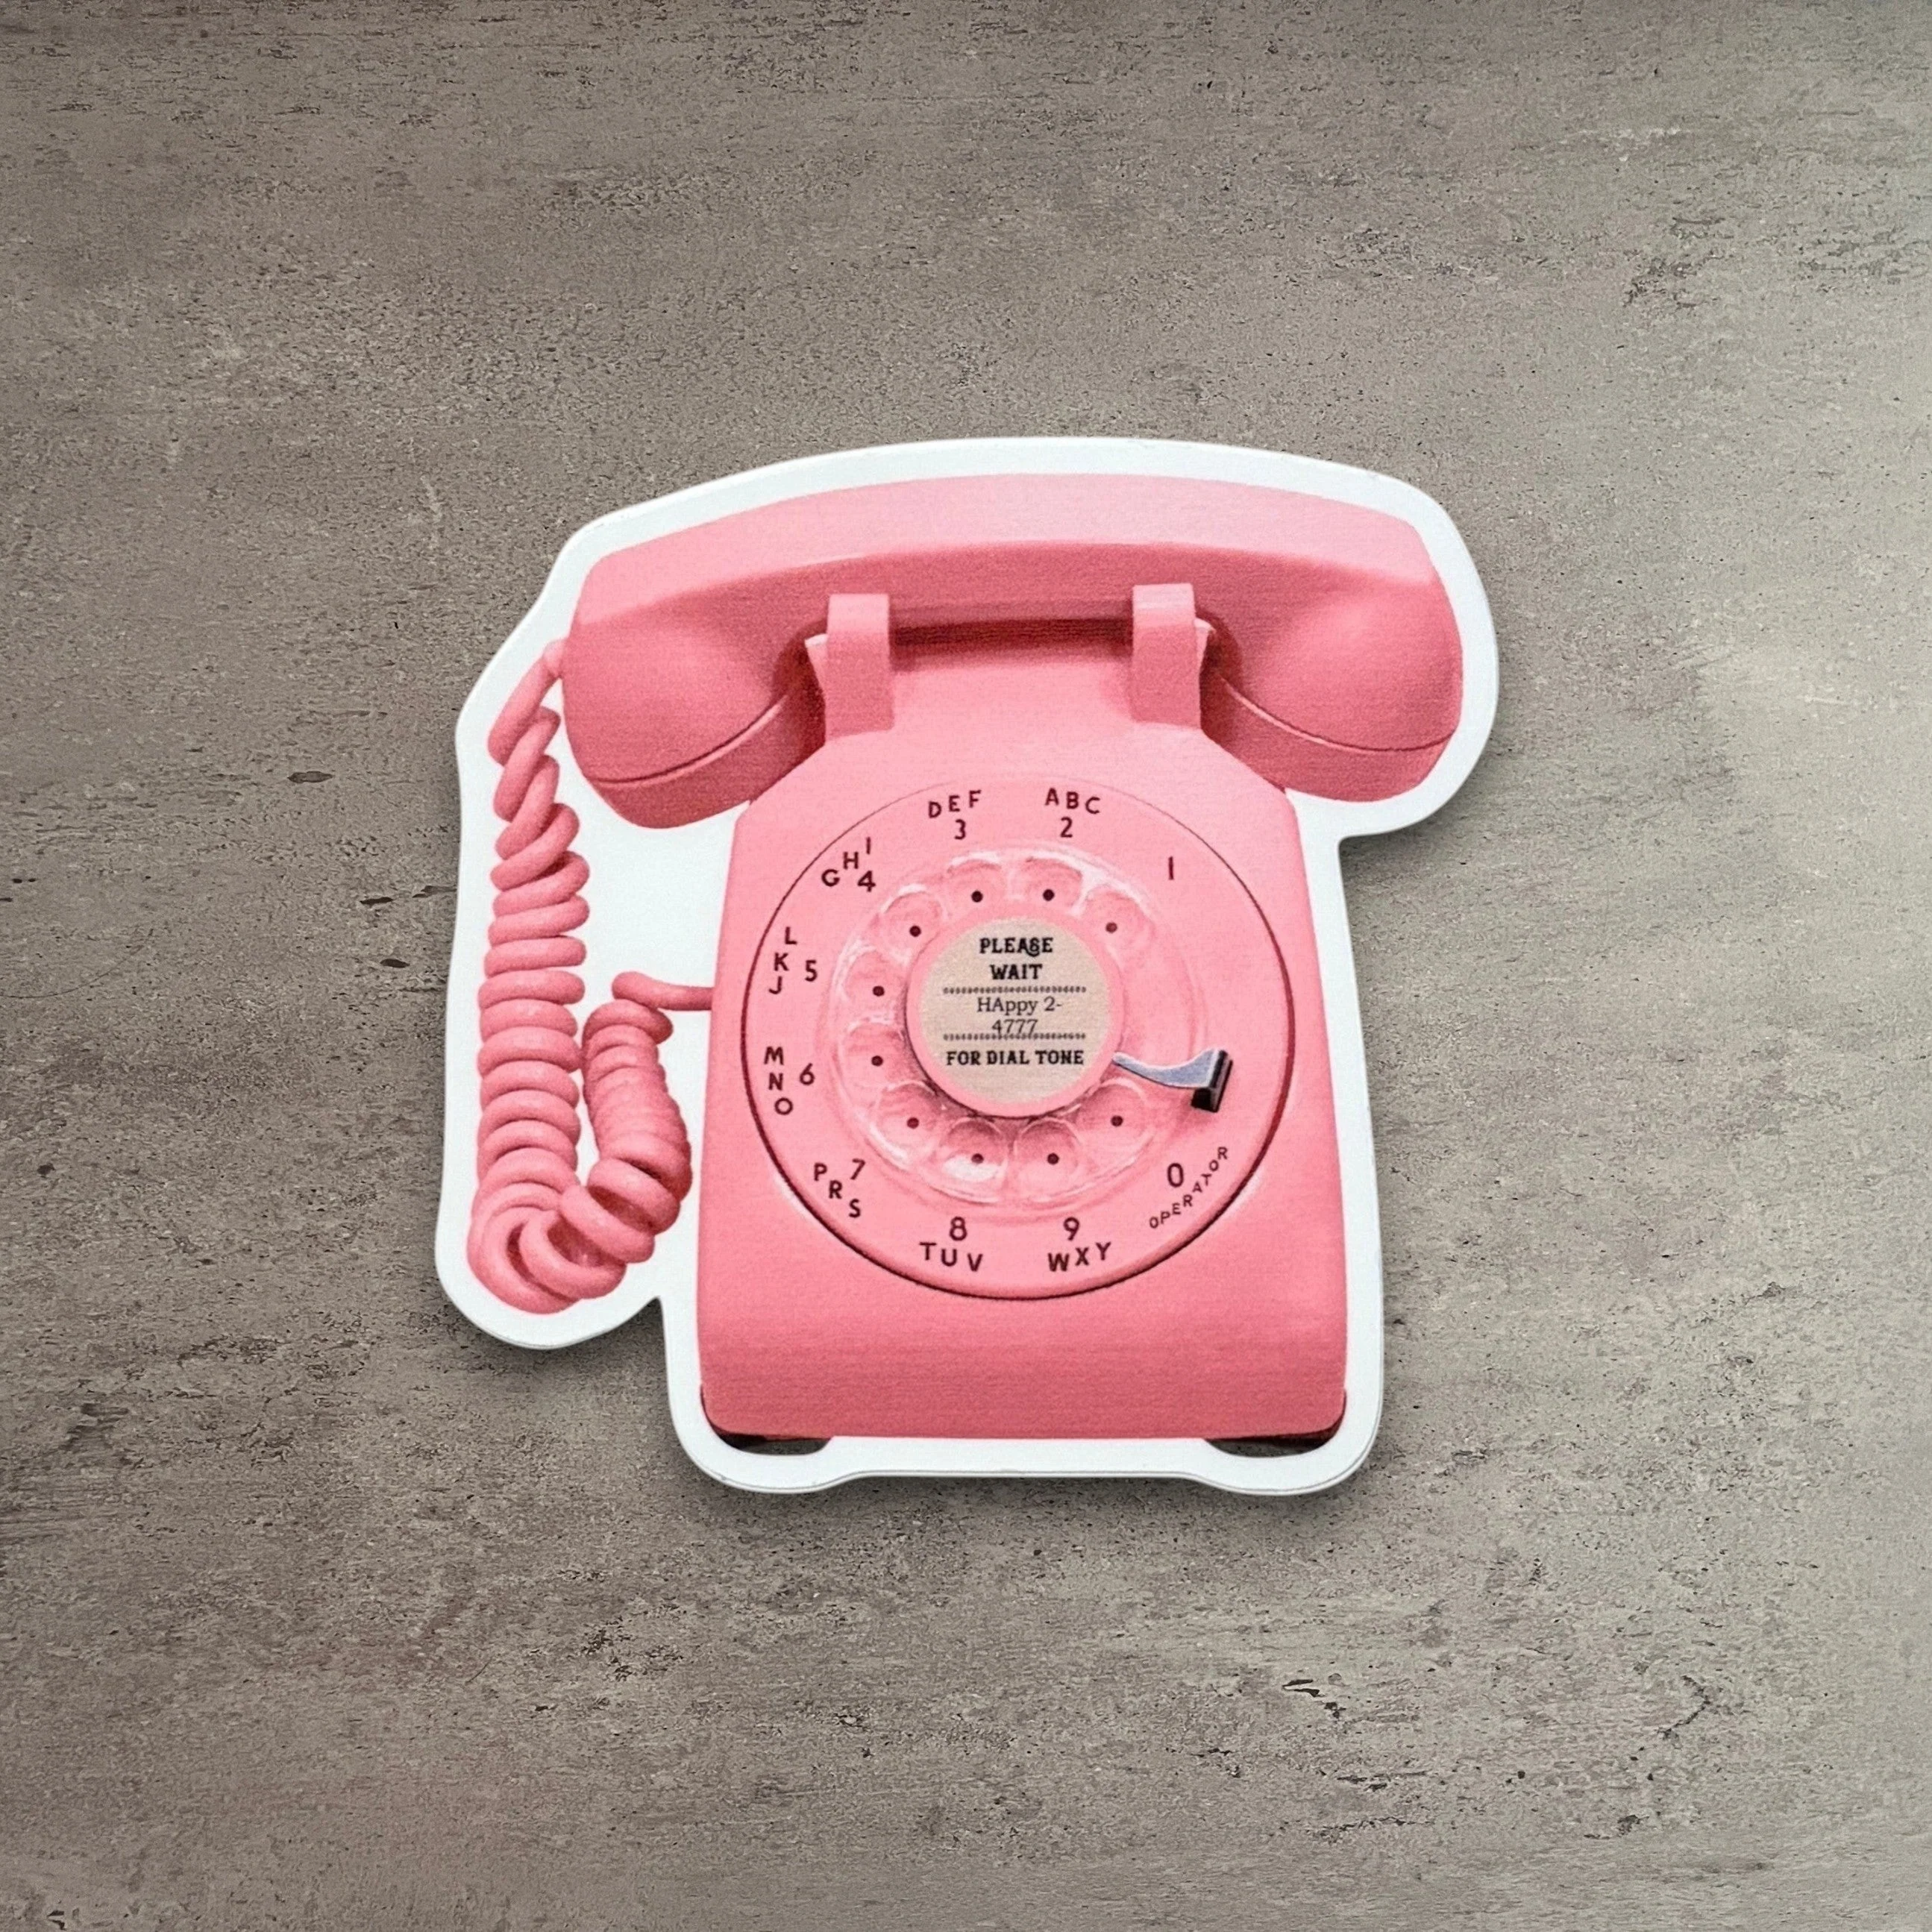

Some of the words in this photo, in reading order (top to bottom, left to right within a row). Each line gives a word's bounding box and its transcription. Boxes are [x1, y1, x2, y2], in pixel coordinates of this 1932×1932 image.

[954, 818, 966, 841] 3
[1059, 816, 1073, 838] 2
[856, 870, 876, 893] 4
[979, 936, 1054, 958] PLEASE
[804, 959, 818, 982] 5
[989, 963, 1043, 980] WAIT
[976, 997, 1038, 1017] HAppy
[991, 1018, 1038, 1035] 4777
[947, 1050, 981, 1066] FOR
[986, 1050, 1030, 1065] DIAL
[1034, 1049, 1084, 1065] TONE
[799, 1062, 815, 1086] 6
[850, 1158, 866, 1181] 7
[1149, 1146, 1229, 1229] OPERATOR
[949, 1216, 968, 1242] 8
[1063, 1216, 1080, 1241] 9
